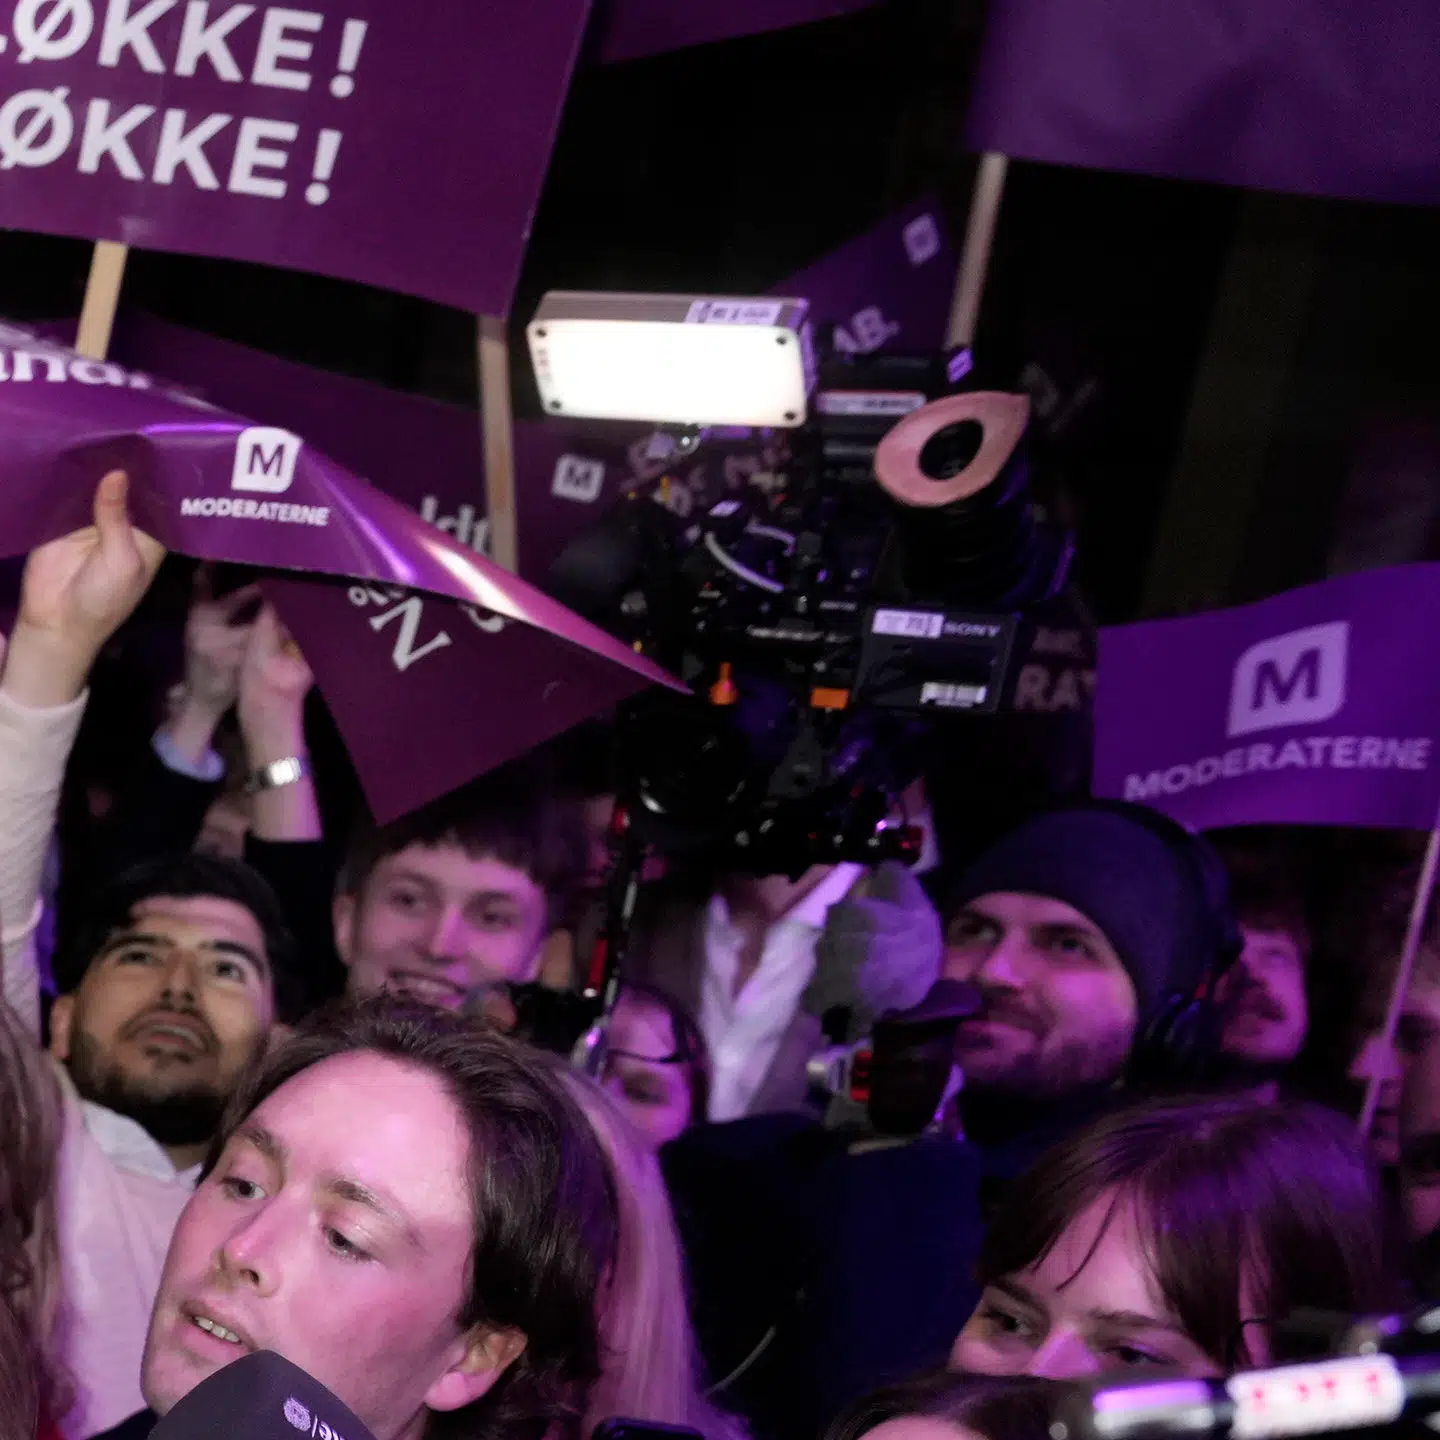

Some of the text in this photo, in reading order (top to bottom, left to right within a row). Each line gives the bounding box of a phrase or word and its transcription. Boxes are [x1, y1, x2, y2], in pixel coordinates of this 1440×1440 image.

[180, 495, 332, 528] MODERATERNE
[1248, 648, 1322, 711] M
[1124, 735, 1432, 802] MODERATERNE
